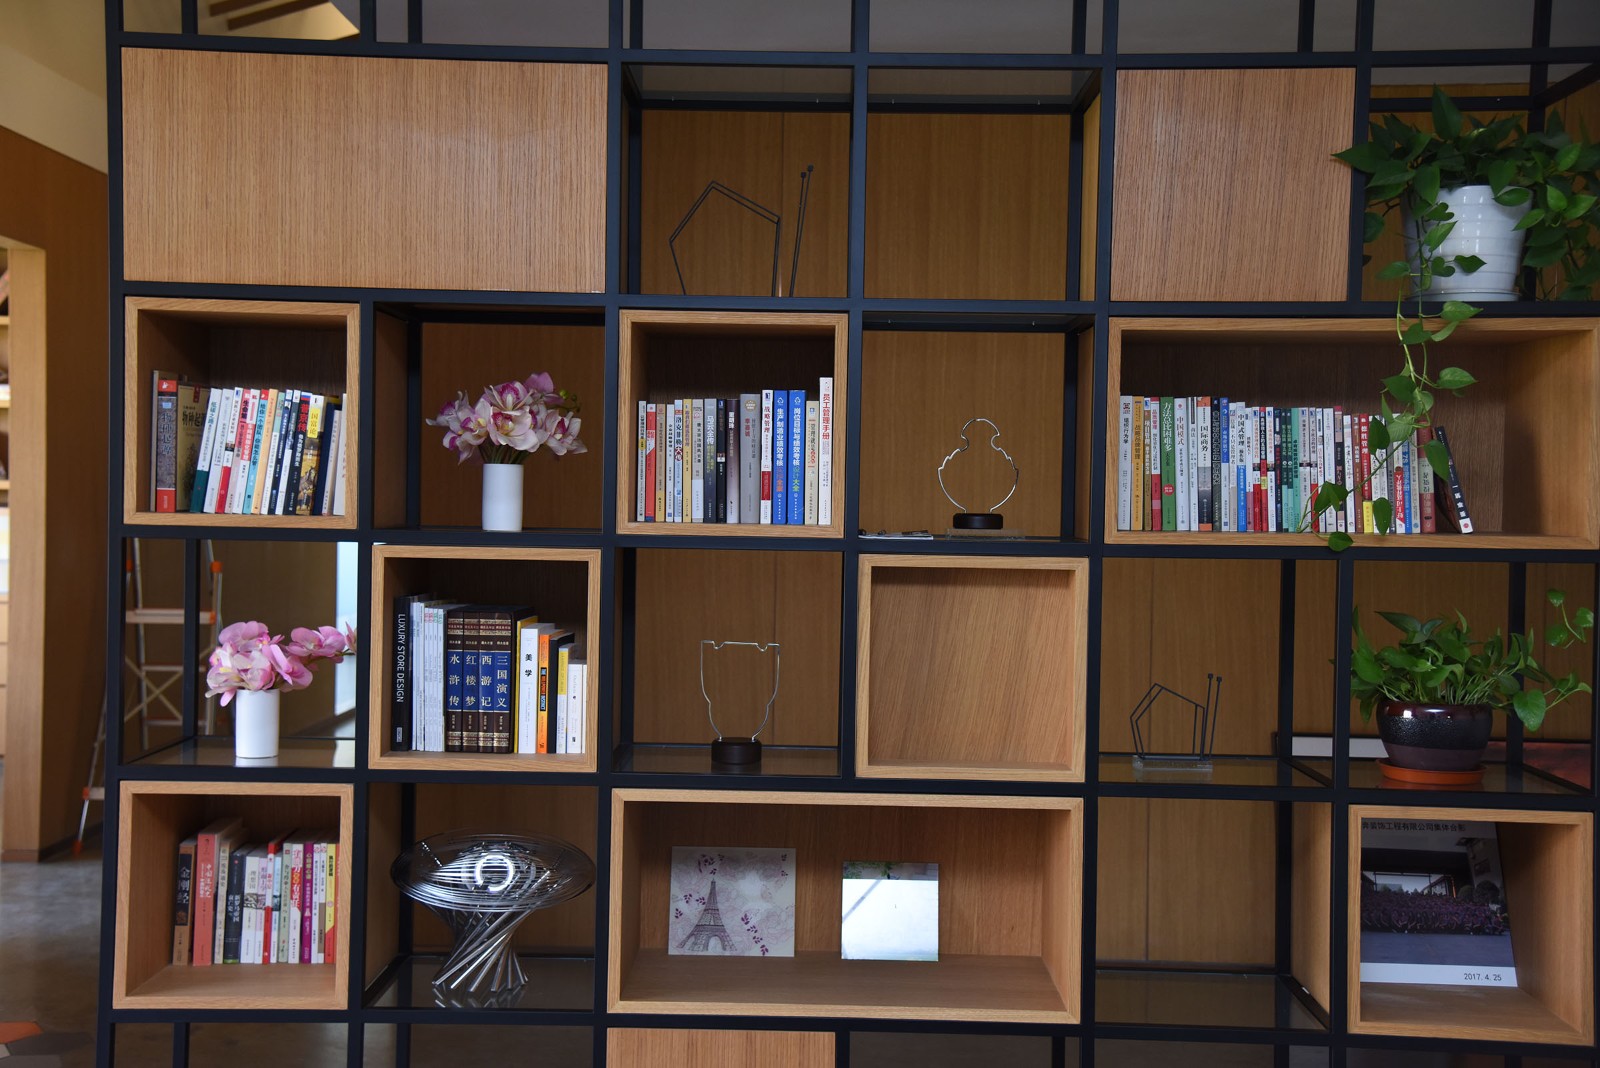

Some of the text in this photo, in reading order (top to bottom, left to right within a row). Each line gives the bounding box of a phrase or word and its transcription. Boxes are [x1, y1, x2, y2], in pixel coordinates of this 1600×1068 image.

[310, 412, 319, 436] 国富论
[822, 394, 830, 440] 员工管理手册
[1162, 402, 1172, 452] 方法总比困难多
[1176, 416, 1184, 446] 中国模式
[1200, 426, 1208, 452] 国际商务
[396, 614, 406, 702] LUXURY STORE DESIGN
[449, 654, 460, 706] 水浒传
[466, 655, 477, 706] 红楼梦
[480, 655, 492, 707] 西游记
[496, 656, 508, 708] 三国演义
